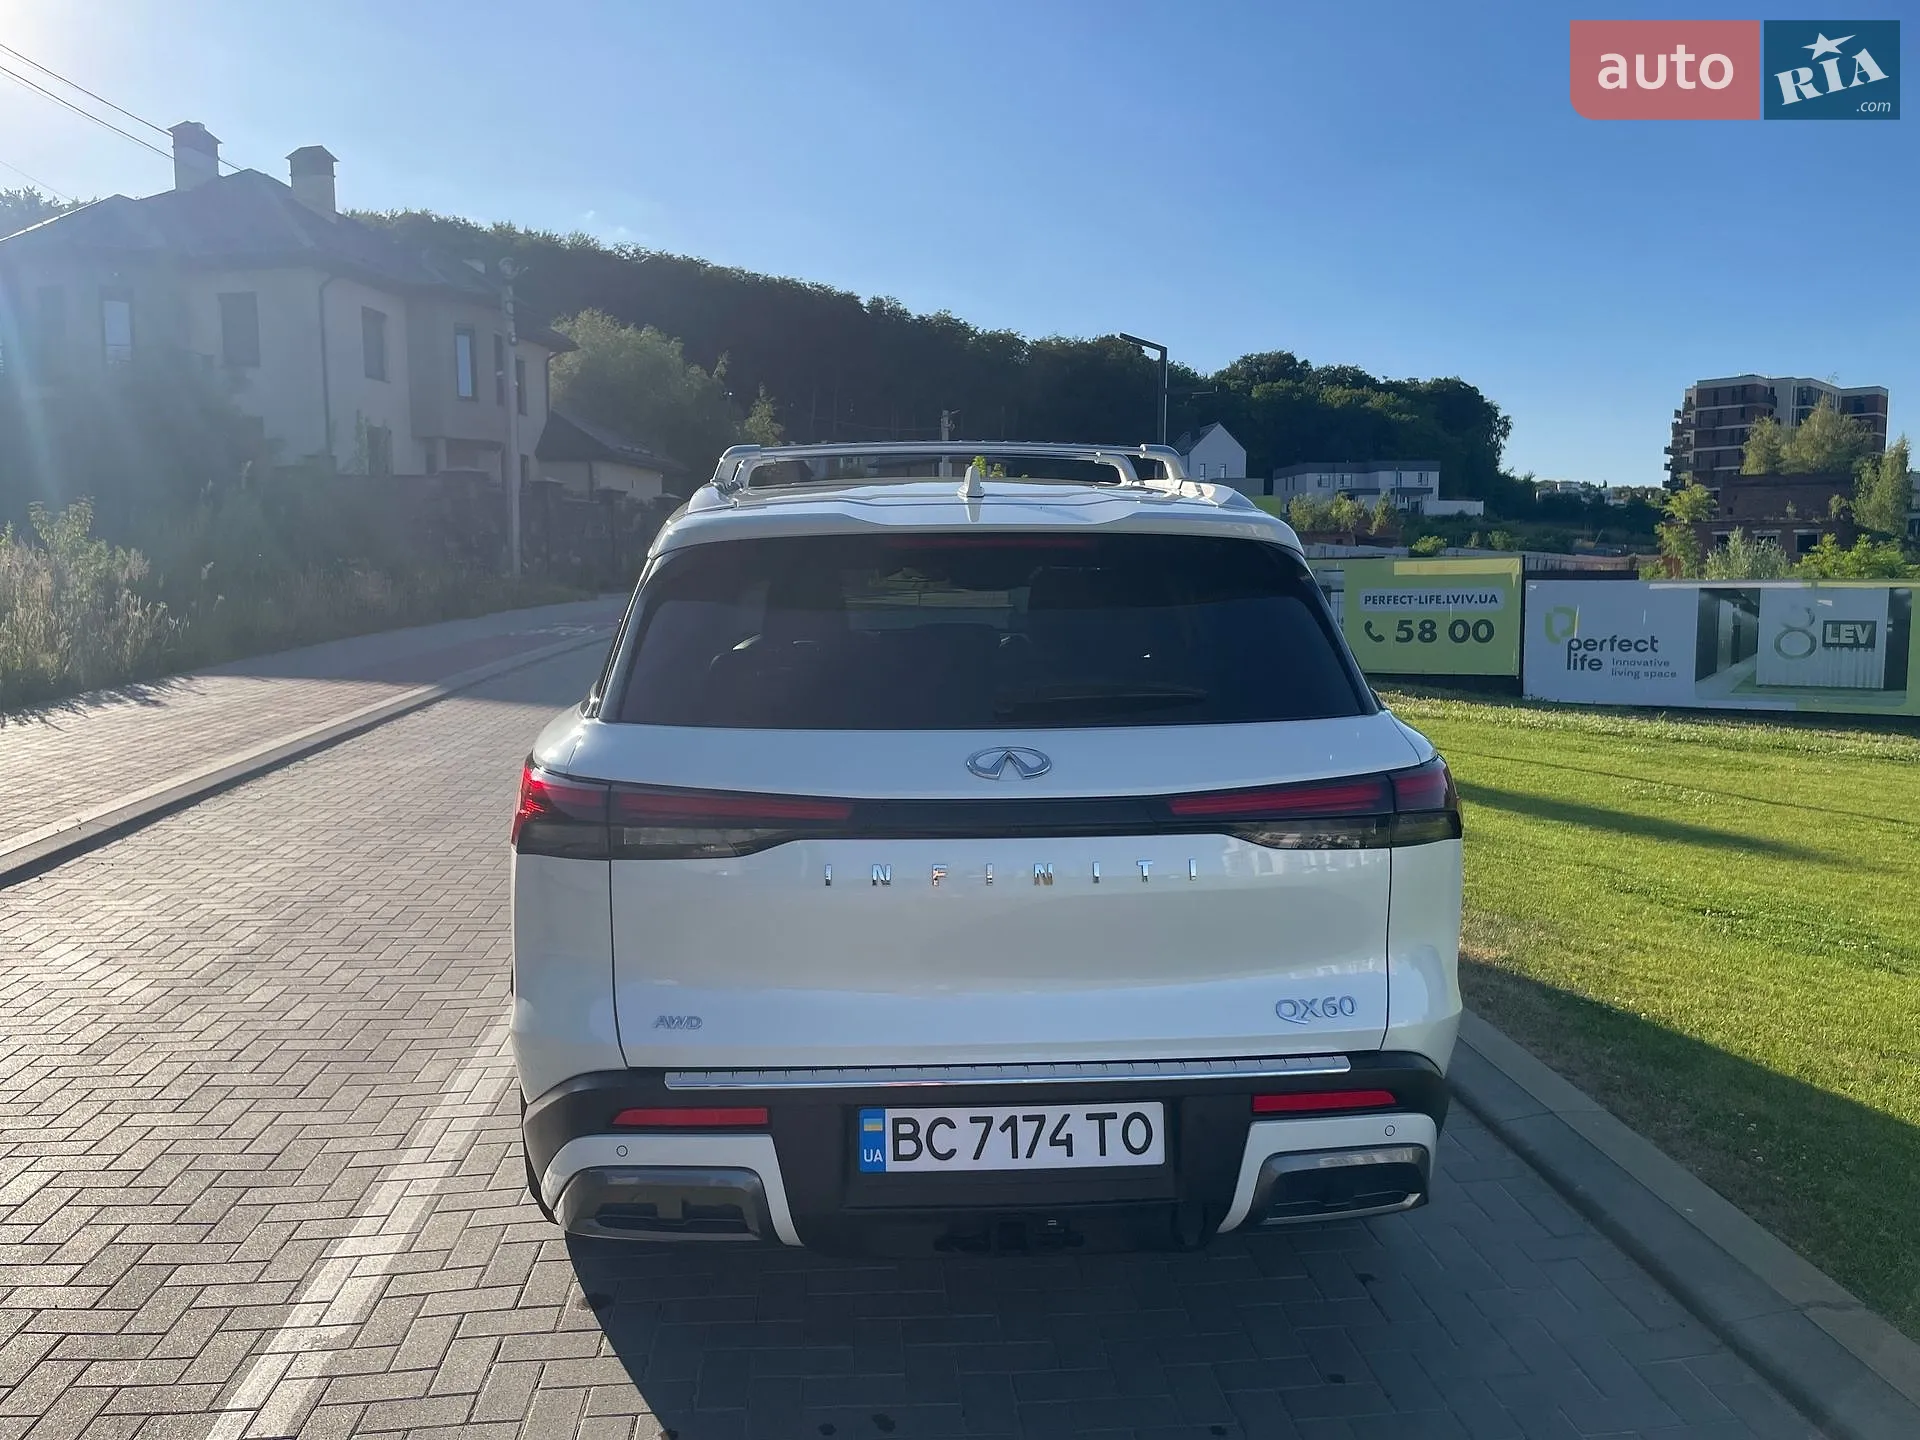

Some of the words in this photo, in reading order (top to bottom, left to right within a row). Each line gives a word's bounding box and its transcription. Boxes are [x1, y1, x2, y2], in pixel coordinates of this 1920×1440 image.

[1364, 594, 1498, 605] PERFECT-LIFE.LVIV.UA
[1395, 619, 1438, 643] 58
[1448, 619, 1495, 643] 00
[1825, 624, 1873, 644] LEV
[1567, 635, 1659, 653] perfect
[1566, 653, 1603, 671] life
[1611, 669, 1640, 680] living
[1643, 671, 1677, 680] space
[824, 857, 1198, 887] INFINITI
[1276, 995, 1357, 1025] QX60
[654, 1015, 703, 1030] AWD
[892, 1116, 957, 1162] BC
[969, 1113, 1074, 1160] 7174
[1085, 1111, 1153, 1157] TO
[863, 1149, 883, 1162] UA
